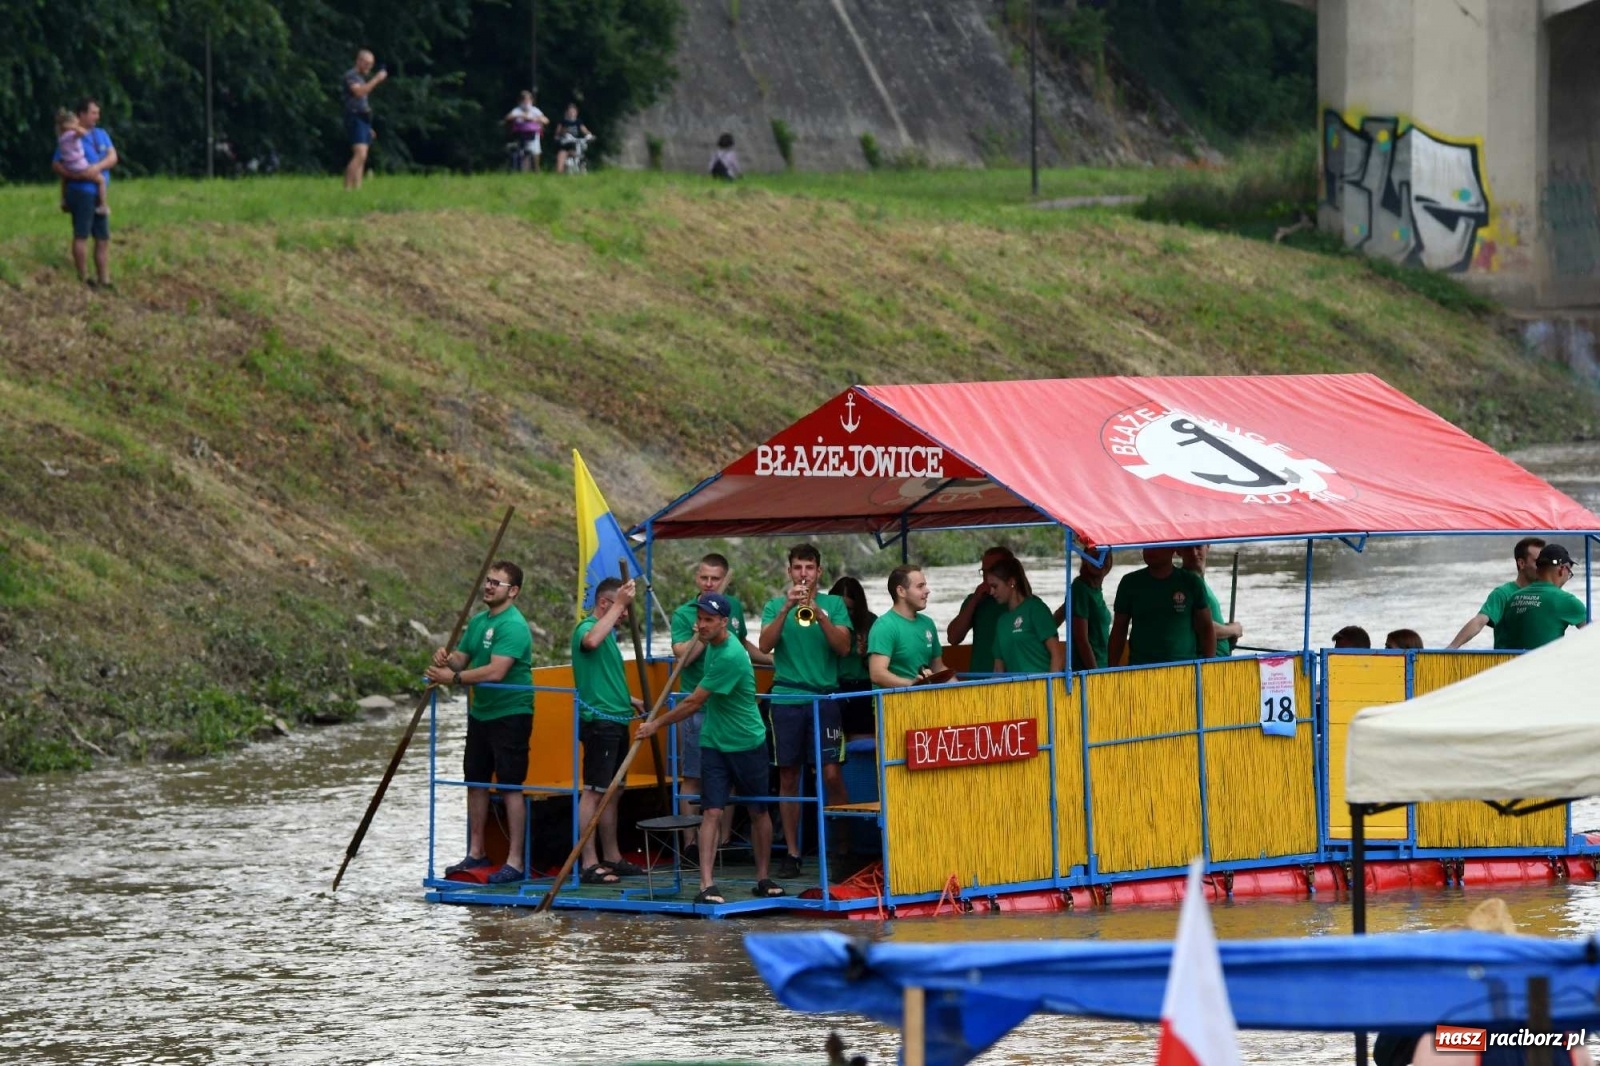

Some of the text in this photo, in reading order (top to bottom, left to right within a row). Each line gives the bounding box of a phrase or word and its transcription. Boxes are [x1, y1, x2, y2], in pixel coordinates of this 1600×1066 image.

[755, 436, 944, 478] BŁAŻEJOWICE
[1263, 696, 1295, 723] 18
[914, 721, 1030, 765] BŁAŻEJOWICE
